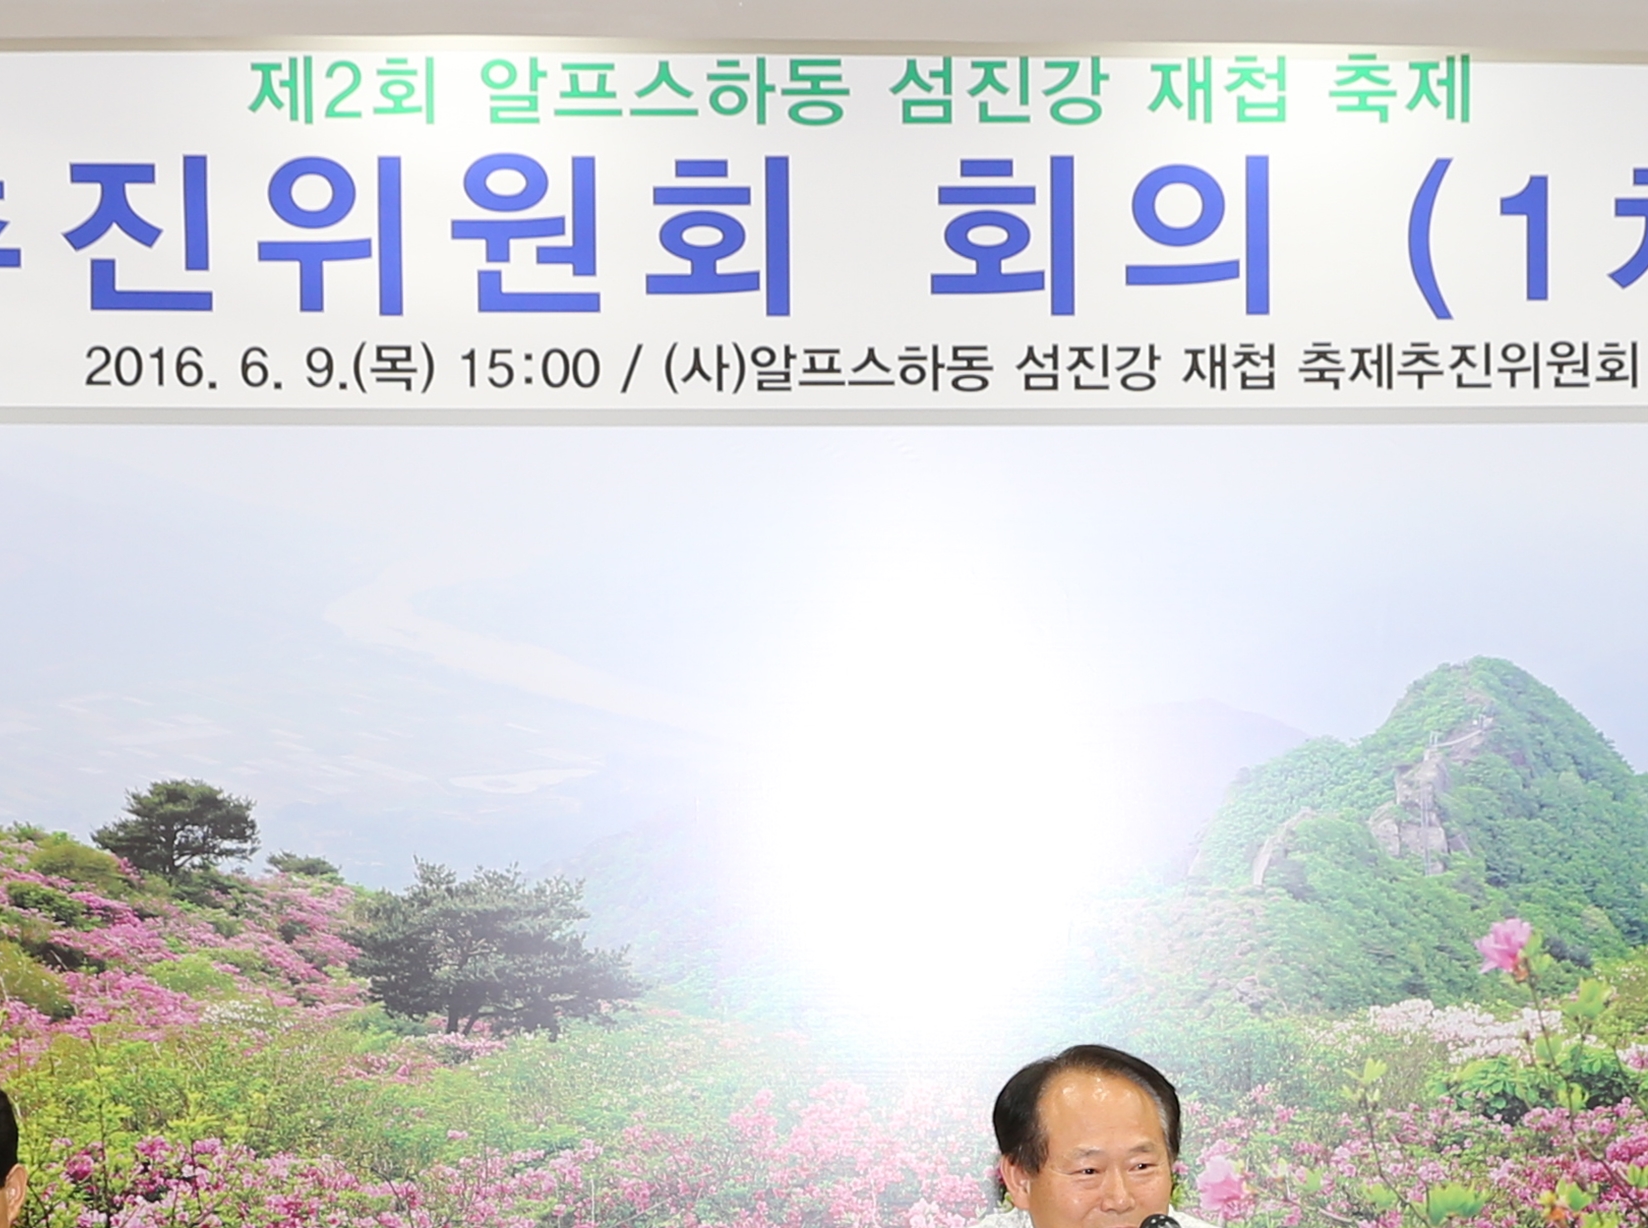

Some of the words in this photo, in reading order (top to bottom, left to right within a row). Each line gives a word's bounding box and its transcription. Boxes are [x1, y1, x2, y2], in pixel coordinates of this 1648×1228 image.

[248, 54, 436, 126] 제2회
[479, 55, 851, 127] 알프스하동
[890, 55, 1111, 127] 섬진강
[1147, 54, 1289, 125] 재첩
[1328, 52, 1474, 125] 축제
[930, 154, 1272, 317] 회의
[84, 344, 218, 388] 2016.
[241, 345, 283, 390] 6.
[305, 341, 436, 394] 9.(목)
[460, 347, 601, 390] 15:00
[663, 341, 995, 394] (사)알프스하동
[1015, 343, 1162, 392] 섬진강
[1181, 342, 1276, 391] 재첩
[1297, 340, 1639, 391] 축제추진위원회
